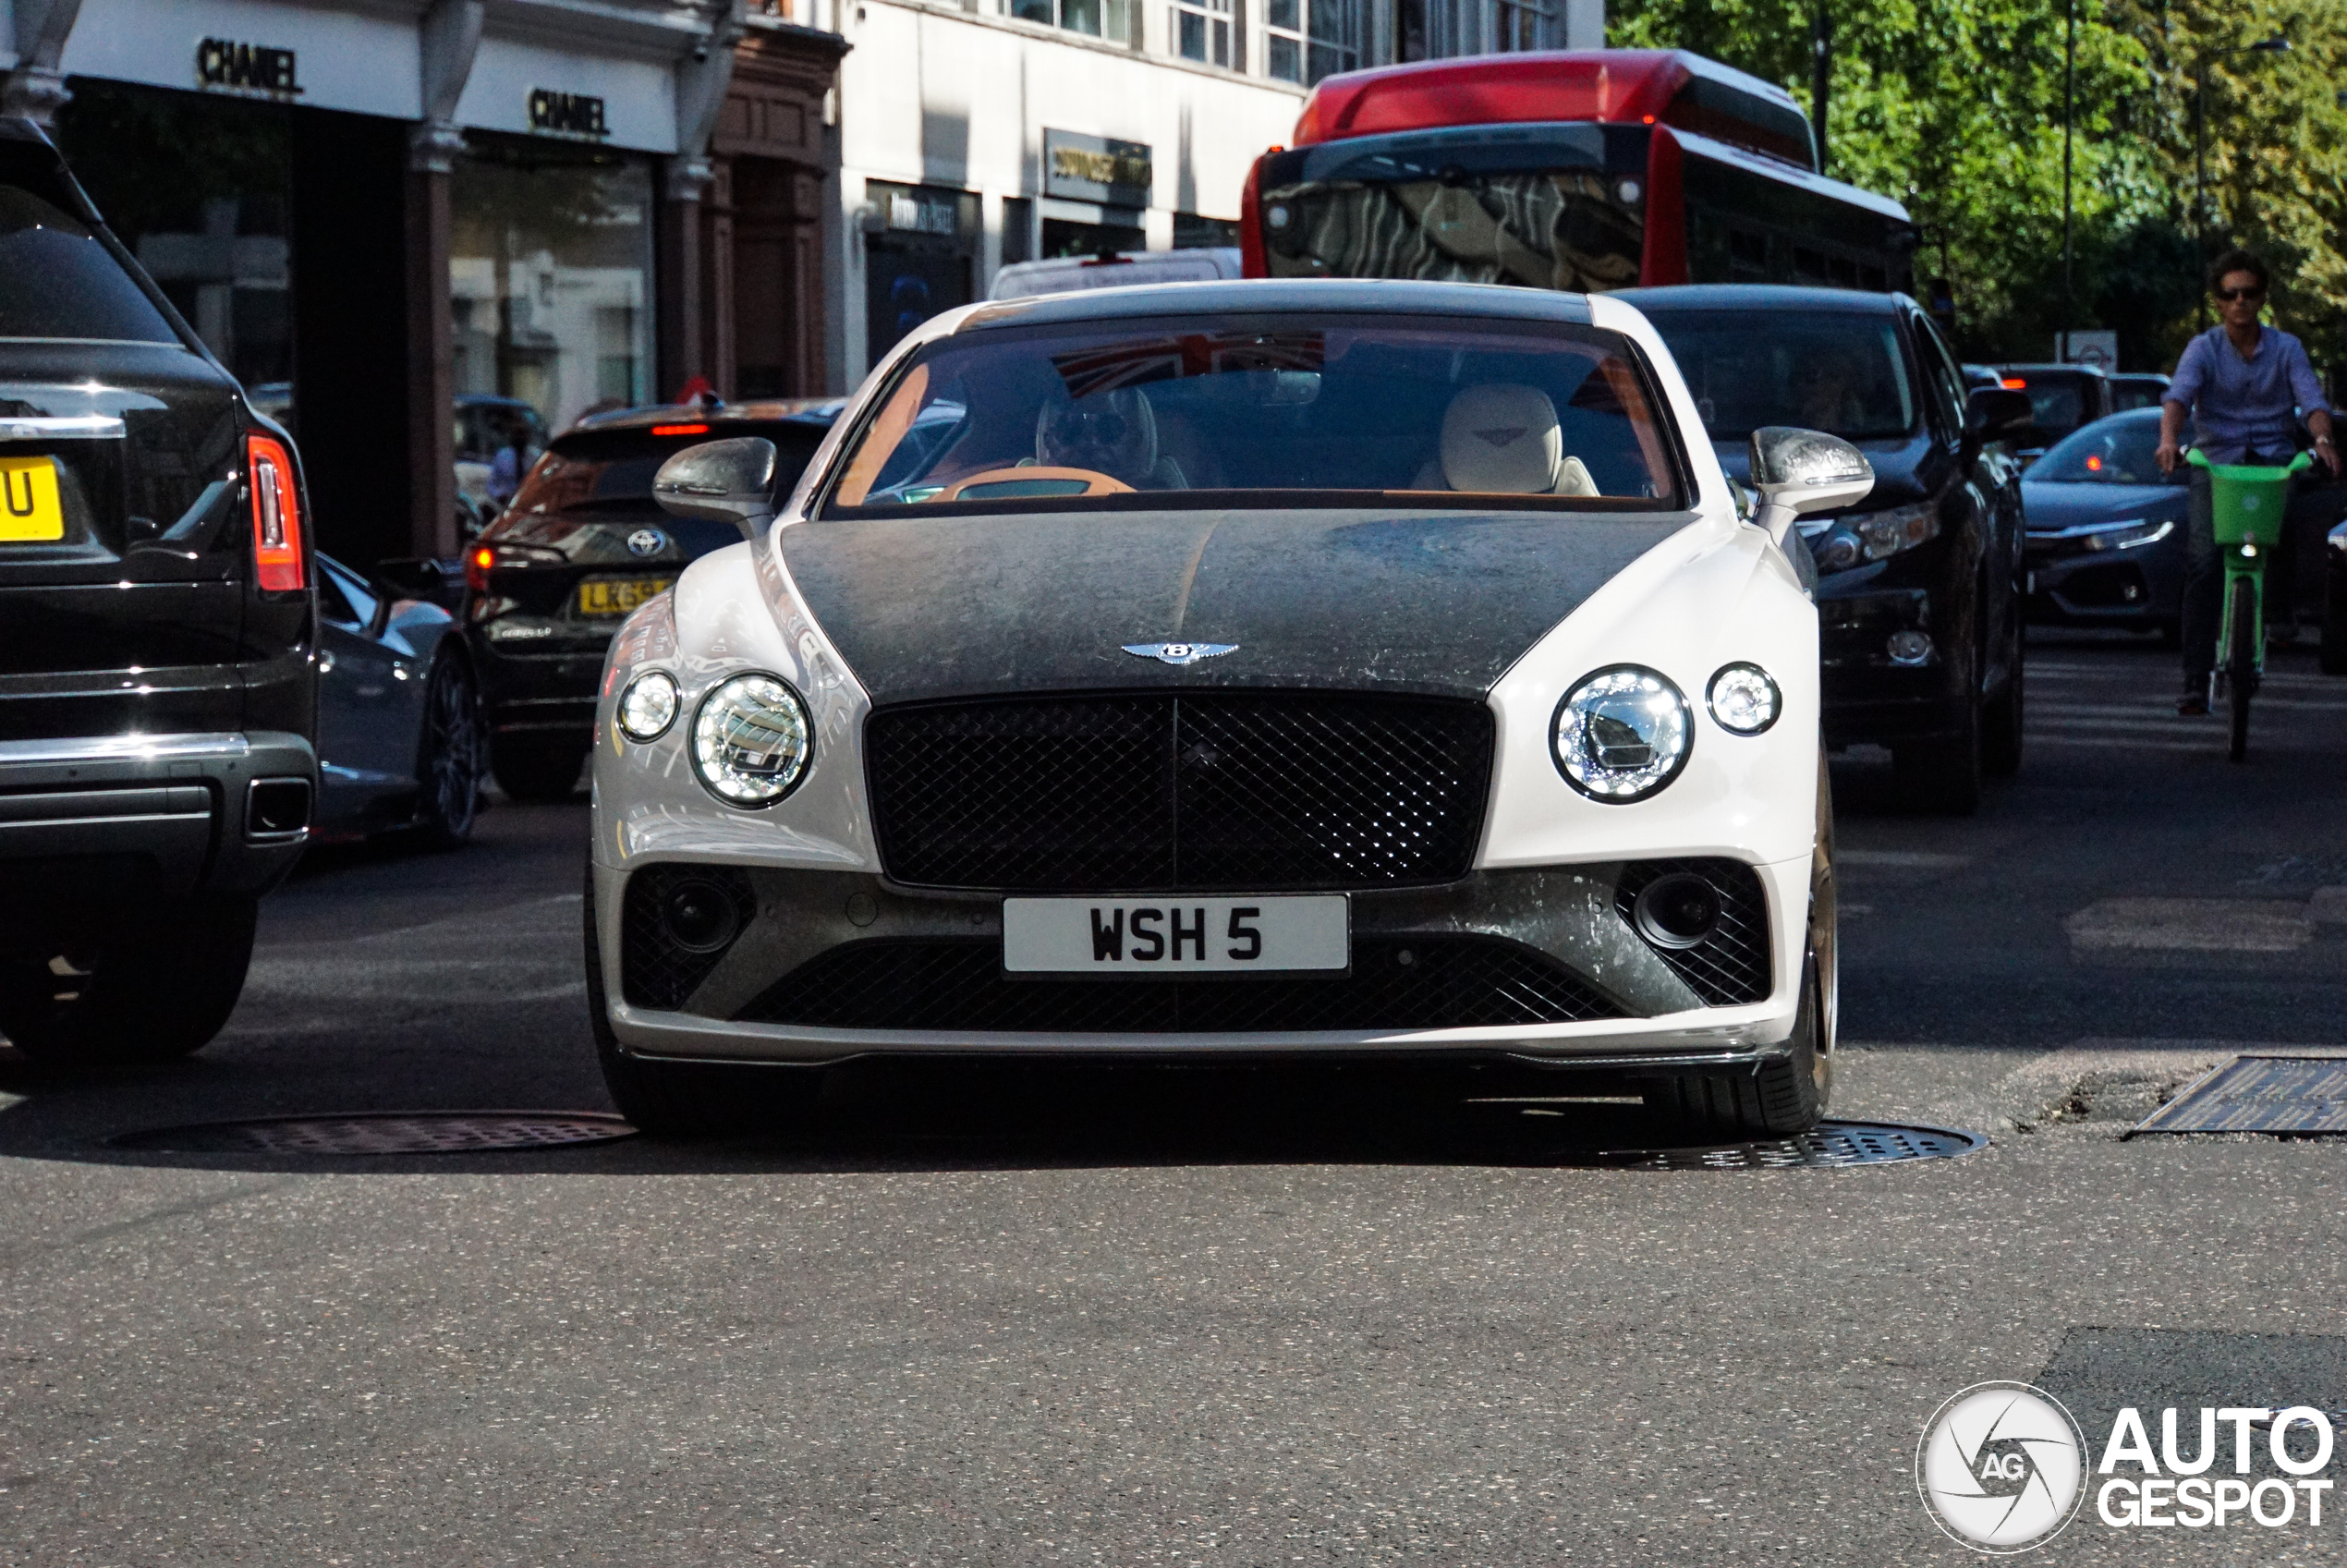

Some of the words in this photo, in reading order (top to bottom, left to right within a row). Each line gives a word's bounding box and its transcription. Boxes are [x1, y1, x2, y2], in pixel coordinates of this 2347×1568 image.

[197, 35, 305, 95] CHANEL
[529, 88, 611, 137] CHANEL
[1090, 906, 1206, 961] WSH
[1227, 906, 1262, 961] 5
